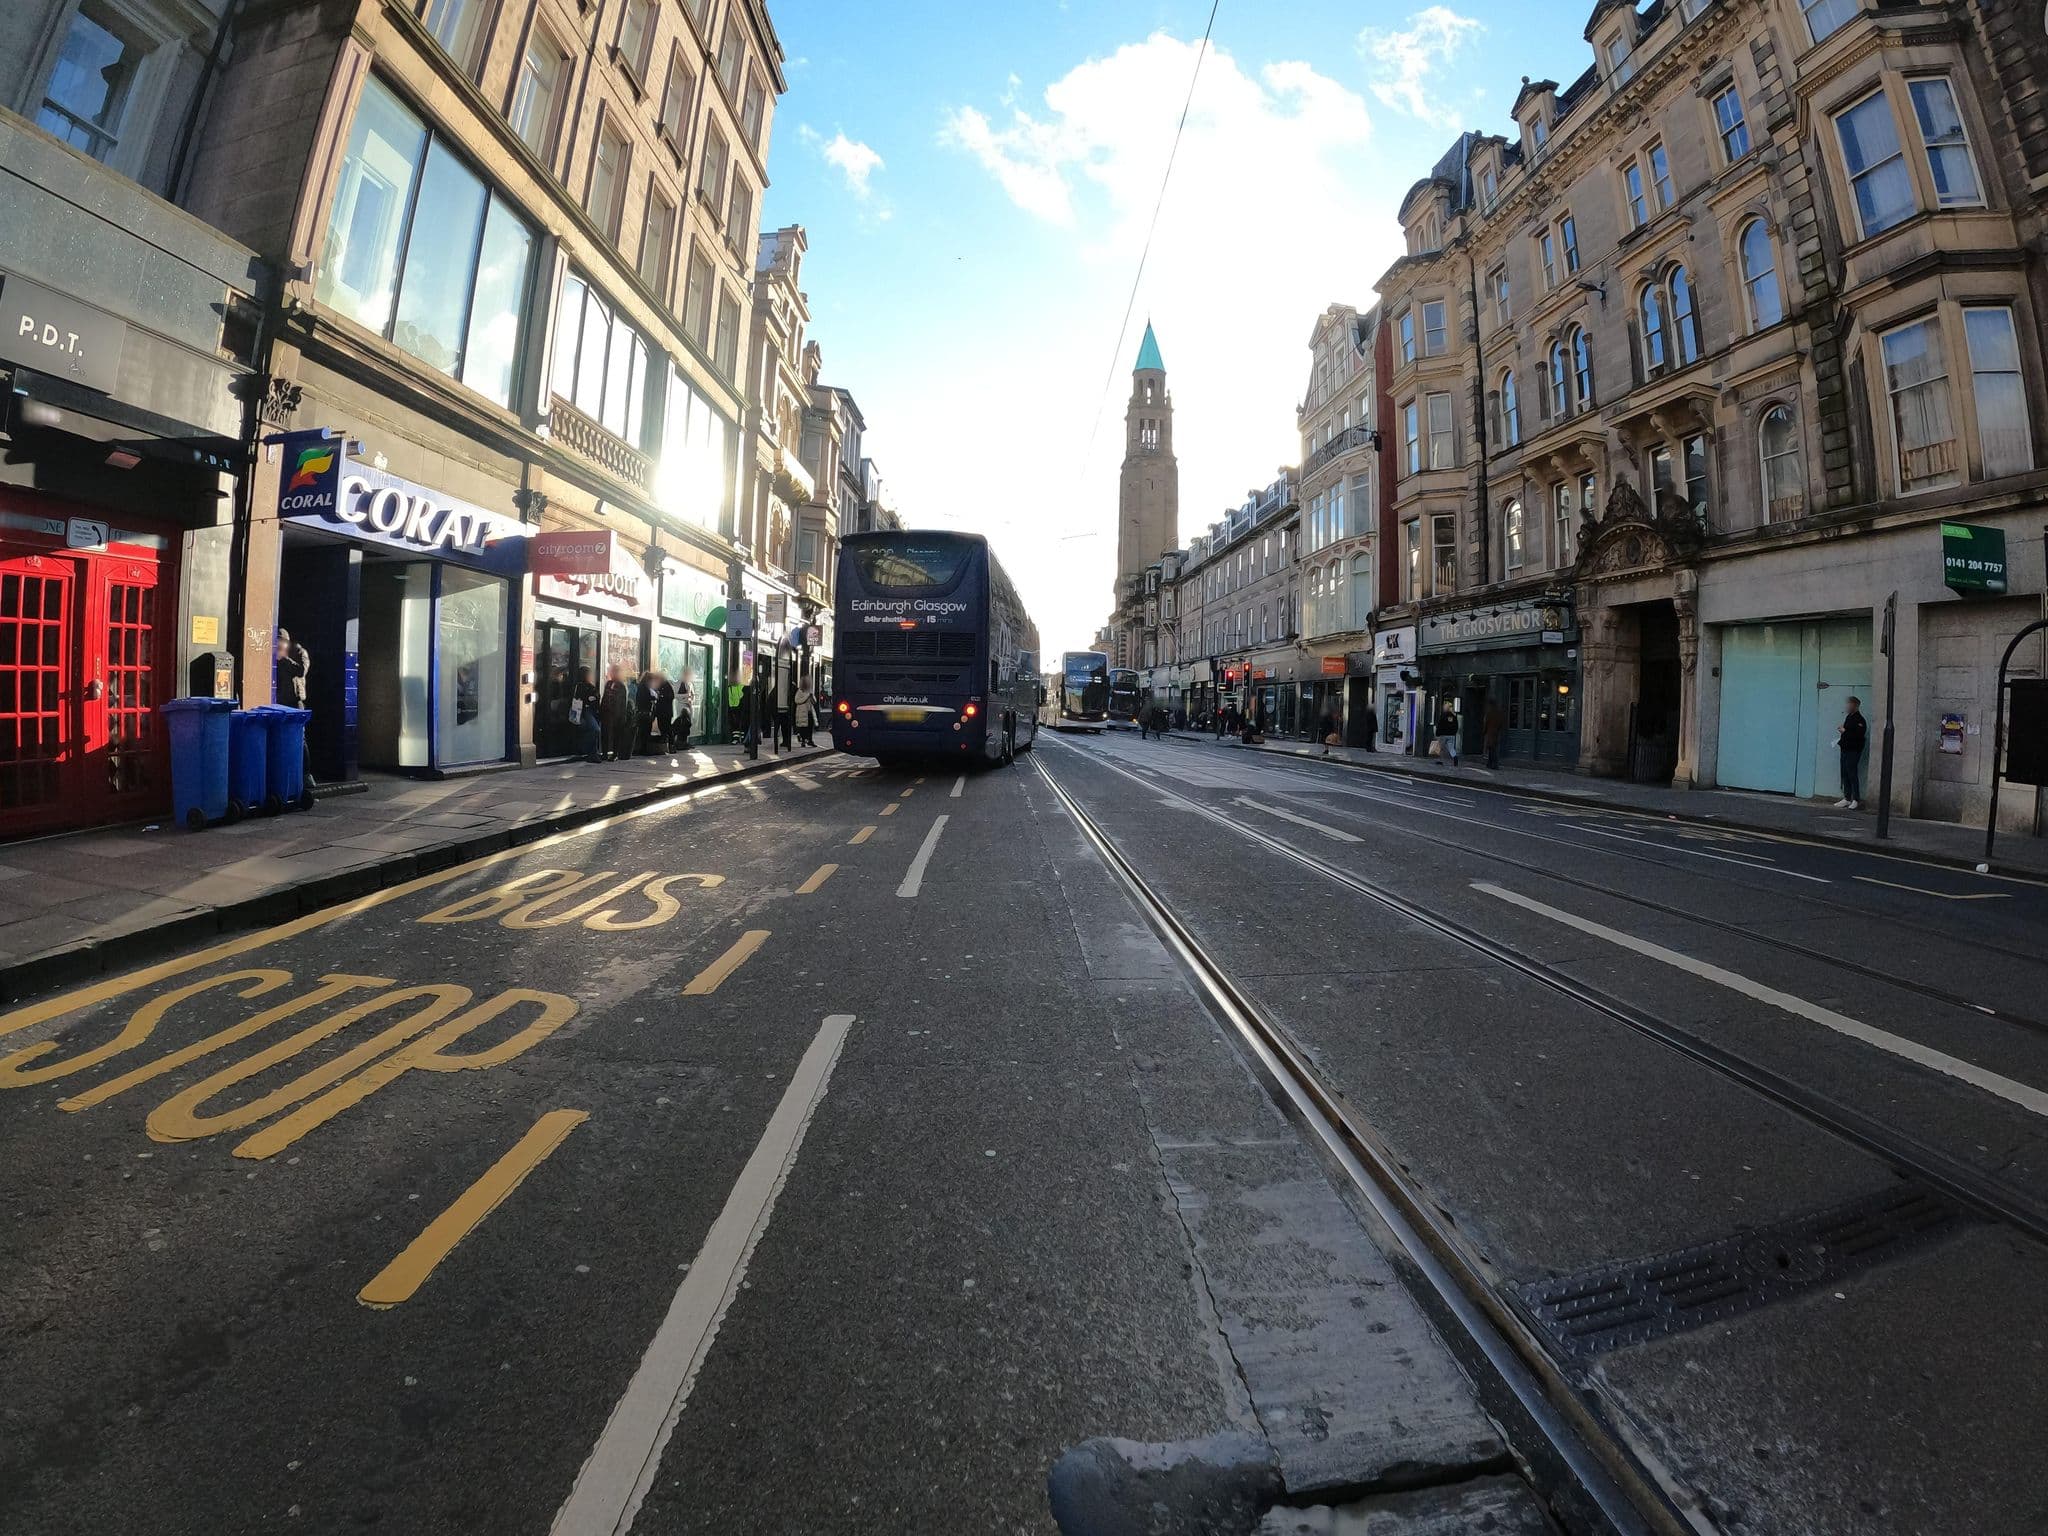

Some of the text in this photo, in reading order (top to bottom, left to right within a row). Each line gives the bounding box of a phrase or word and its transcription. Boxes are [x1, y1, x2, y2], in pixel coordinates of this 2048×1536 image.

[19, 315, 84, 357] P.D.T.
[281, 492, 333, 510] CORAL
[336, 474, 492, 556] CORAL
[1946, 557, 2003, 573] 0141 204 7757
[851, 599, 967, 615] Edinburgh Glasgow
[864, 615, 881, 623] 24hr
[926, 615, 937, 623] 15
[1440, 610, 1542, 640] THE GROSVENOR
[883, 695, 929, 705] citylink.co.uk
[417, 870, 725, 932] BUS
[0, 968, 581, 1160] STOP
